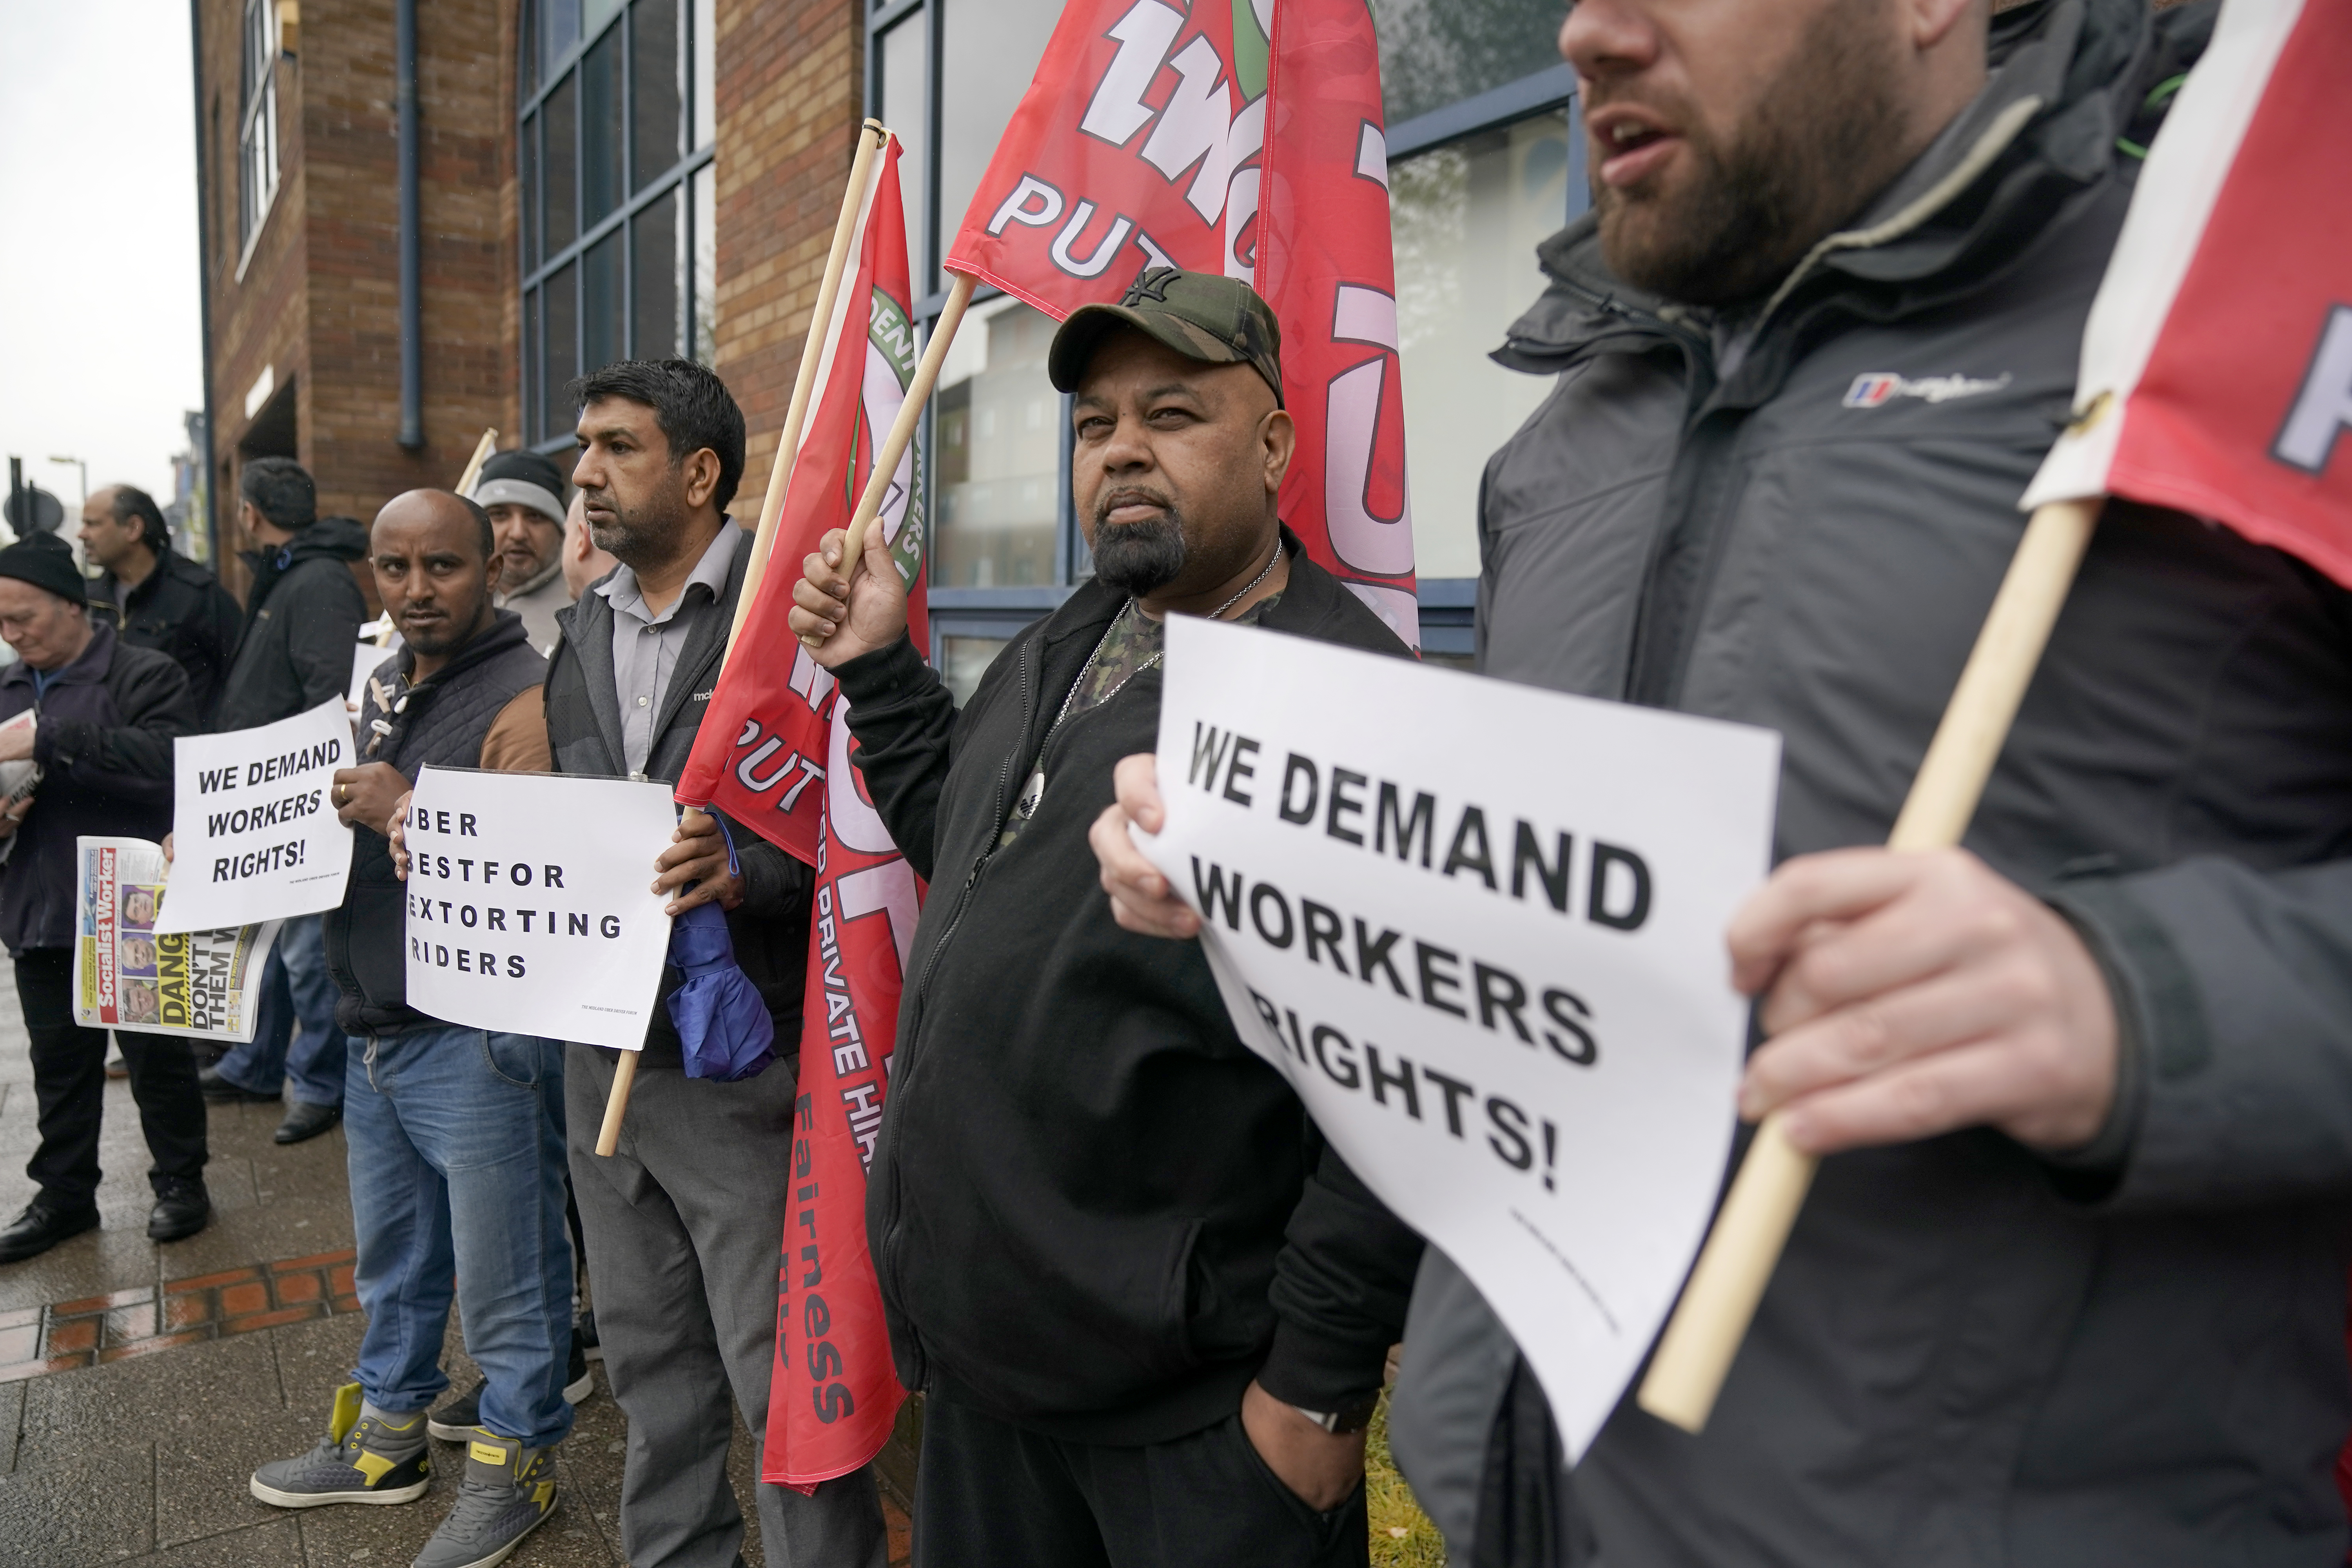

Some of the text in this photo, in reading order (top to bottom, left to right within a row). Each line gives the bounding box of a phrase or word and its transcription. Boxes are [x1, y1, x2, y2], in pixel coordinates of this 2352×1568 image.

[985, 171, 1181, 280] PUT
[199, 739, 340, 794] WE DEMAND
[209, 789, 322, 838] WORKERS
[406, 806, 478, 837] UBER
[1188, 720, 1655, 937] WE DEMAND
[213, 839, 305, 883] RIGHTS!
[98, 848, 114, 1008] Socialist Worker
[409, 893, 621, 939] EXTORTING
[412, 936, 526, 978] RIDERS
[158, 933, 186, 1025] DANG
[192, 944, 210, 1029] DON'T
[209, 952, 231, 1030] THEM
[818, 881, 872, 1079] PRIVATE
[1191, 855, 1602, 1072] WORKERS
[840, 1079, 883, 1181] HIR
[1245, 982, 1560, 1196] RIGHTS!
[794, 1091, 855, 1425] Fairness
